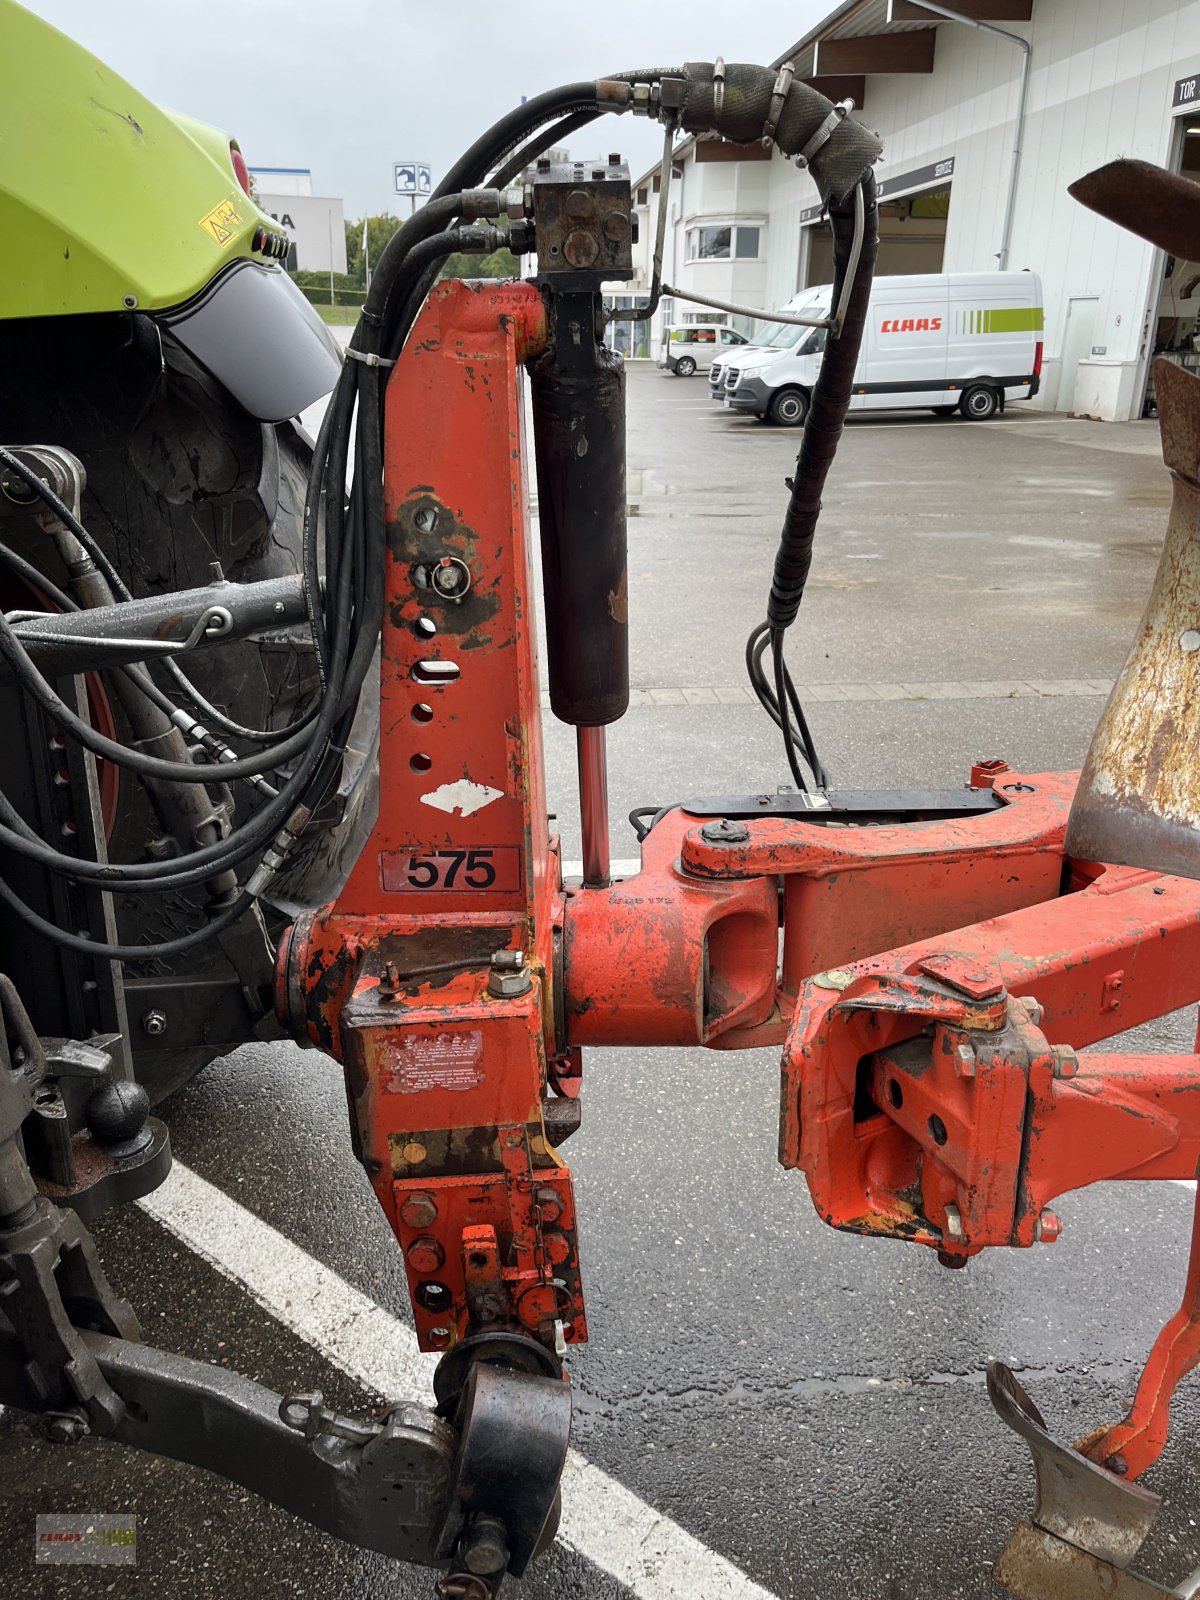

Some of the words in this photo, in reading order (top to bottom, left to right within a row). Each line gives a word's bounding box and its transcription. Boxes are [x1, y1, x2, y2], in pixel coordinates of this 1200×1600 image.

[1179, 79, 1196, 101] TOR
[881, 317, 942, 333] CLAAS
[407, 850, 496, 889] 575
